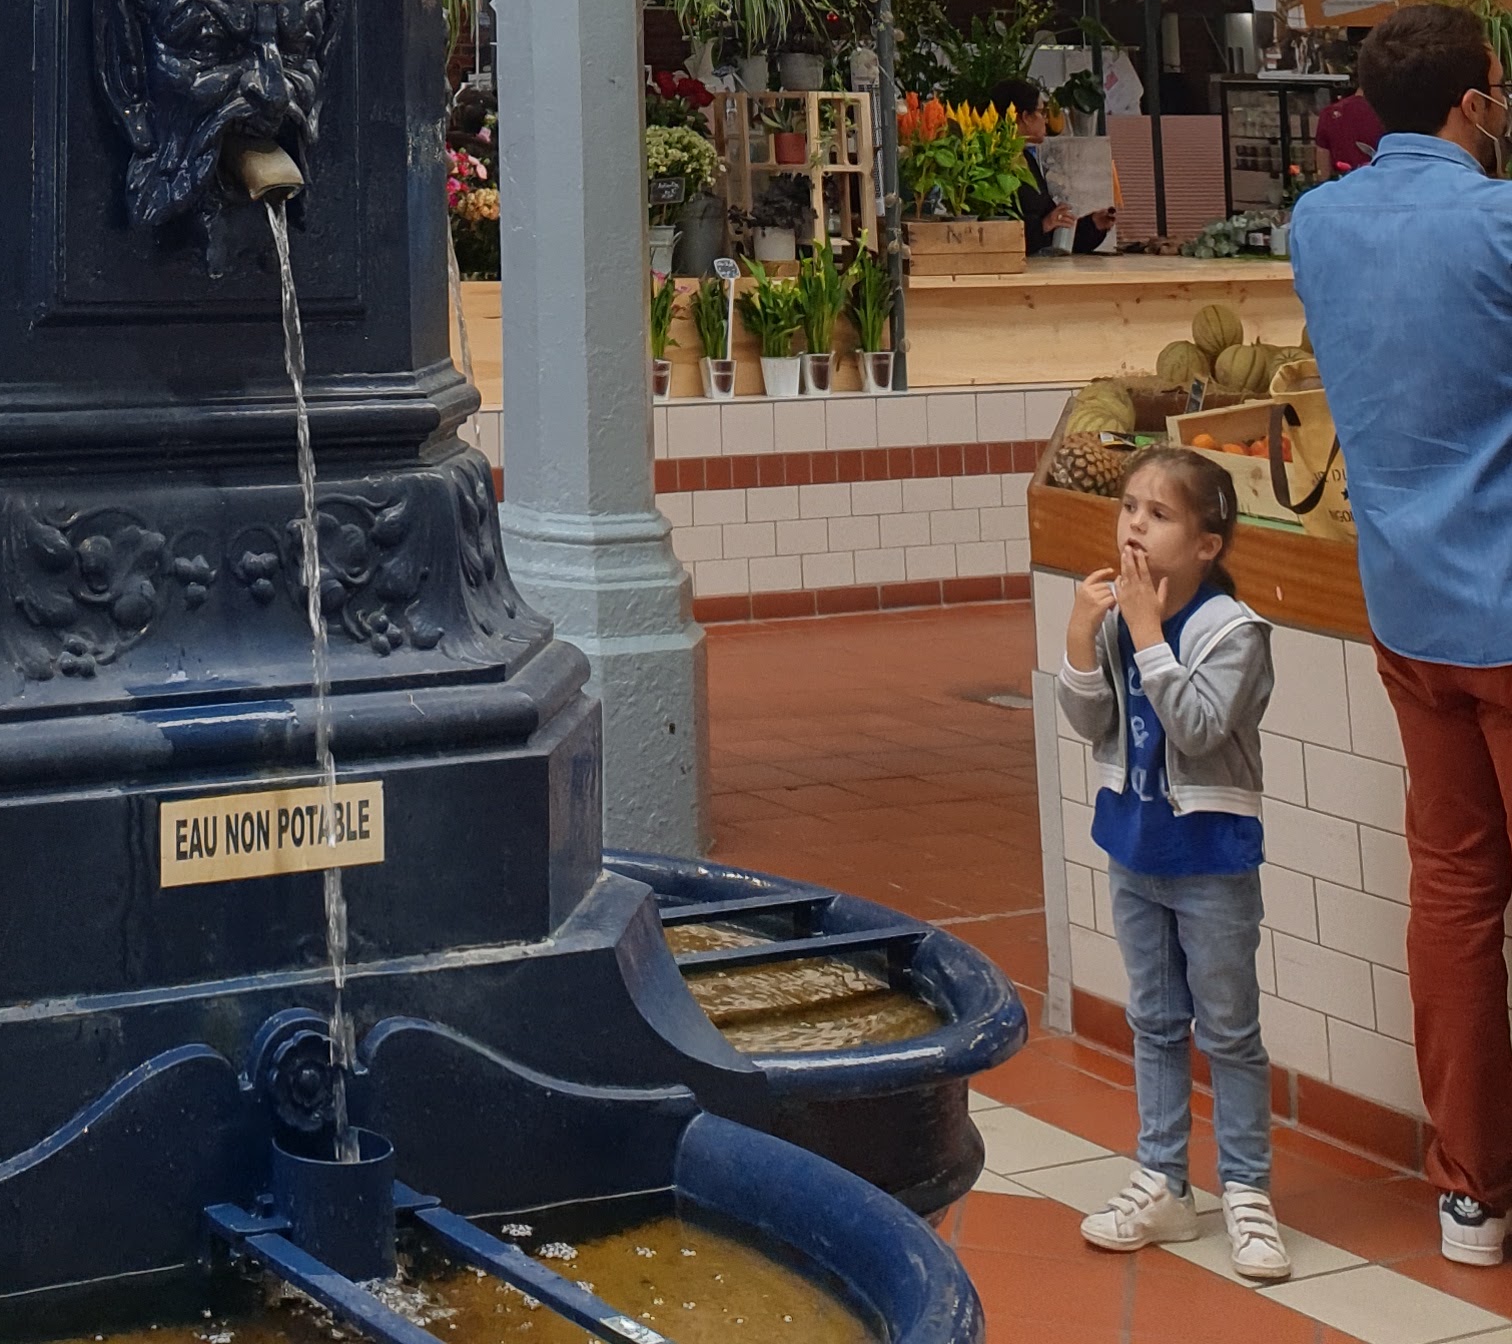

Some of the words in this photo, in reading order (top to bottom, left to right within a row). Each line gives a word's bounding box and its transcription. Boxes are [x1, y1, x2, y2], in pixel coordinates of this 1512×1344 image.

[175, 815, 218, 861] EAU
[226, 810, 270, 855] NON
[277, 799, 370, 850] POTABLE
